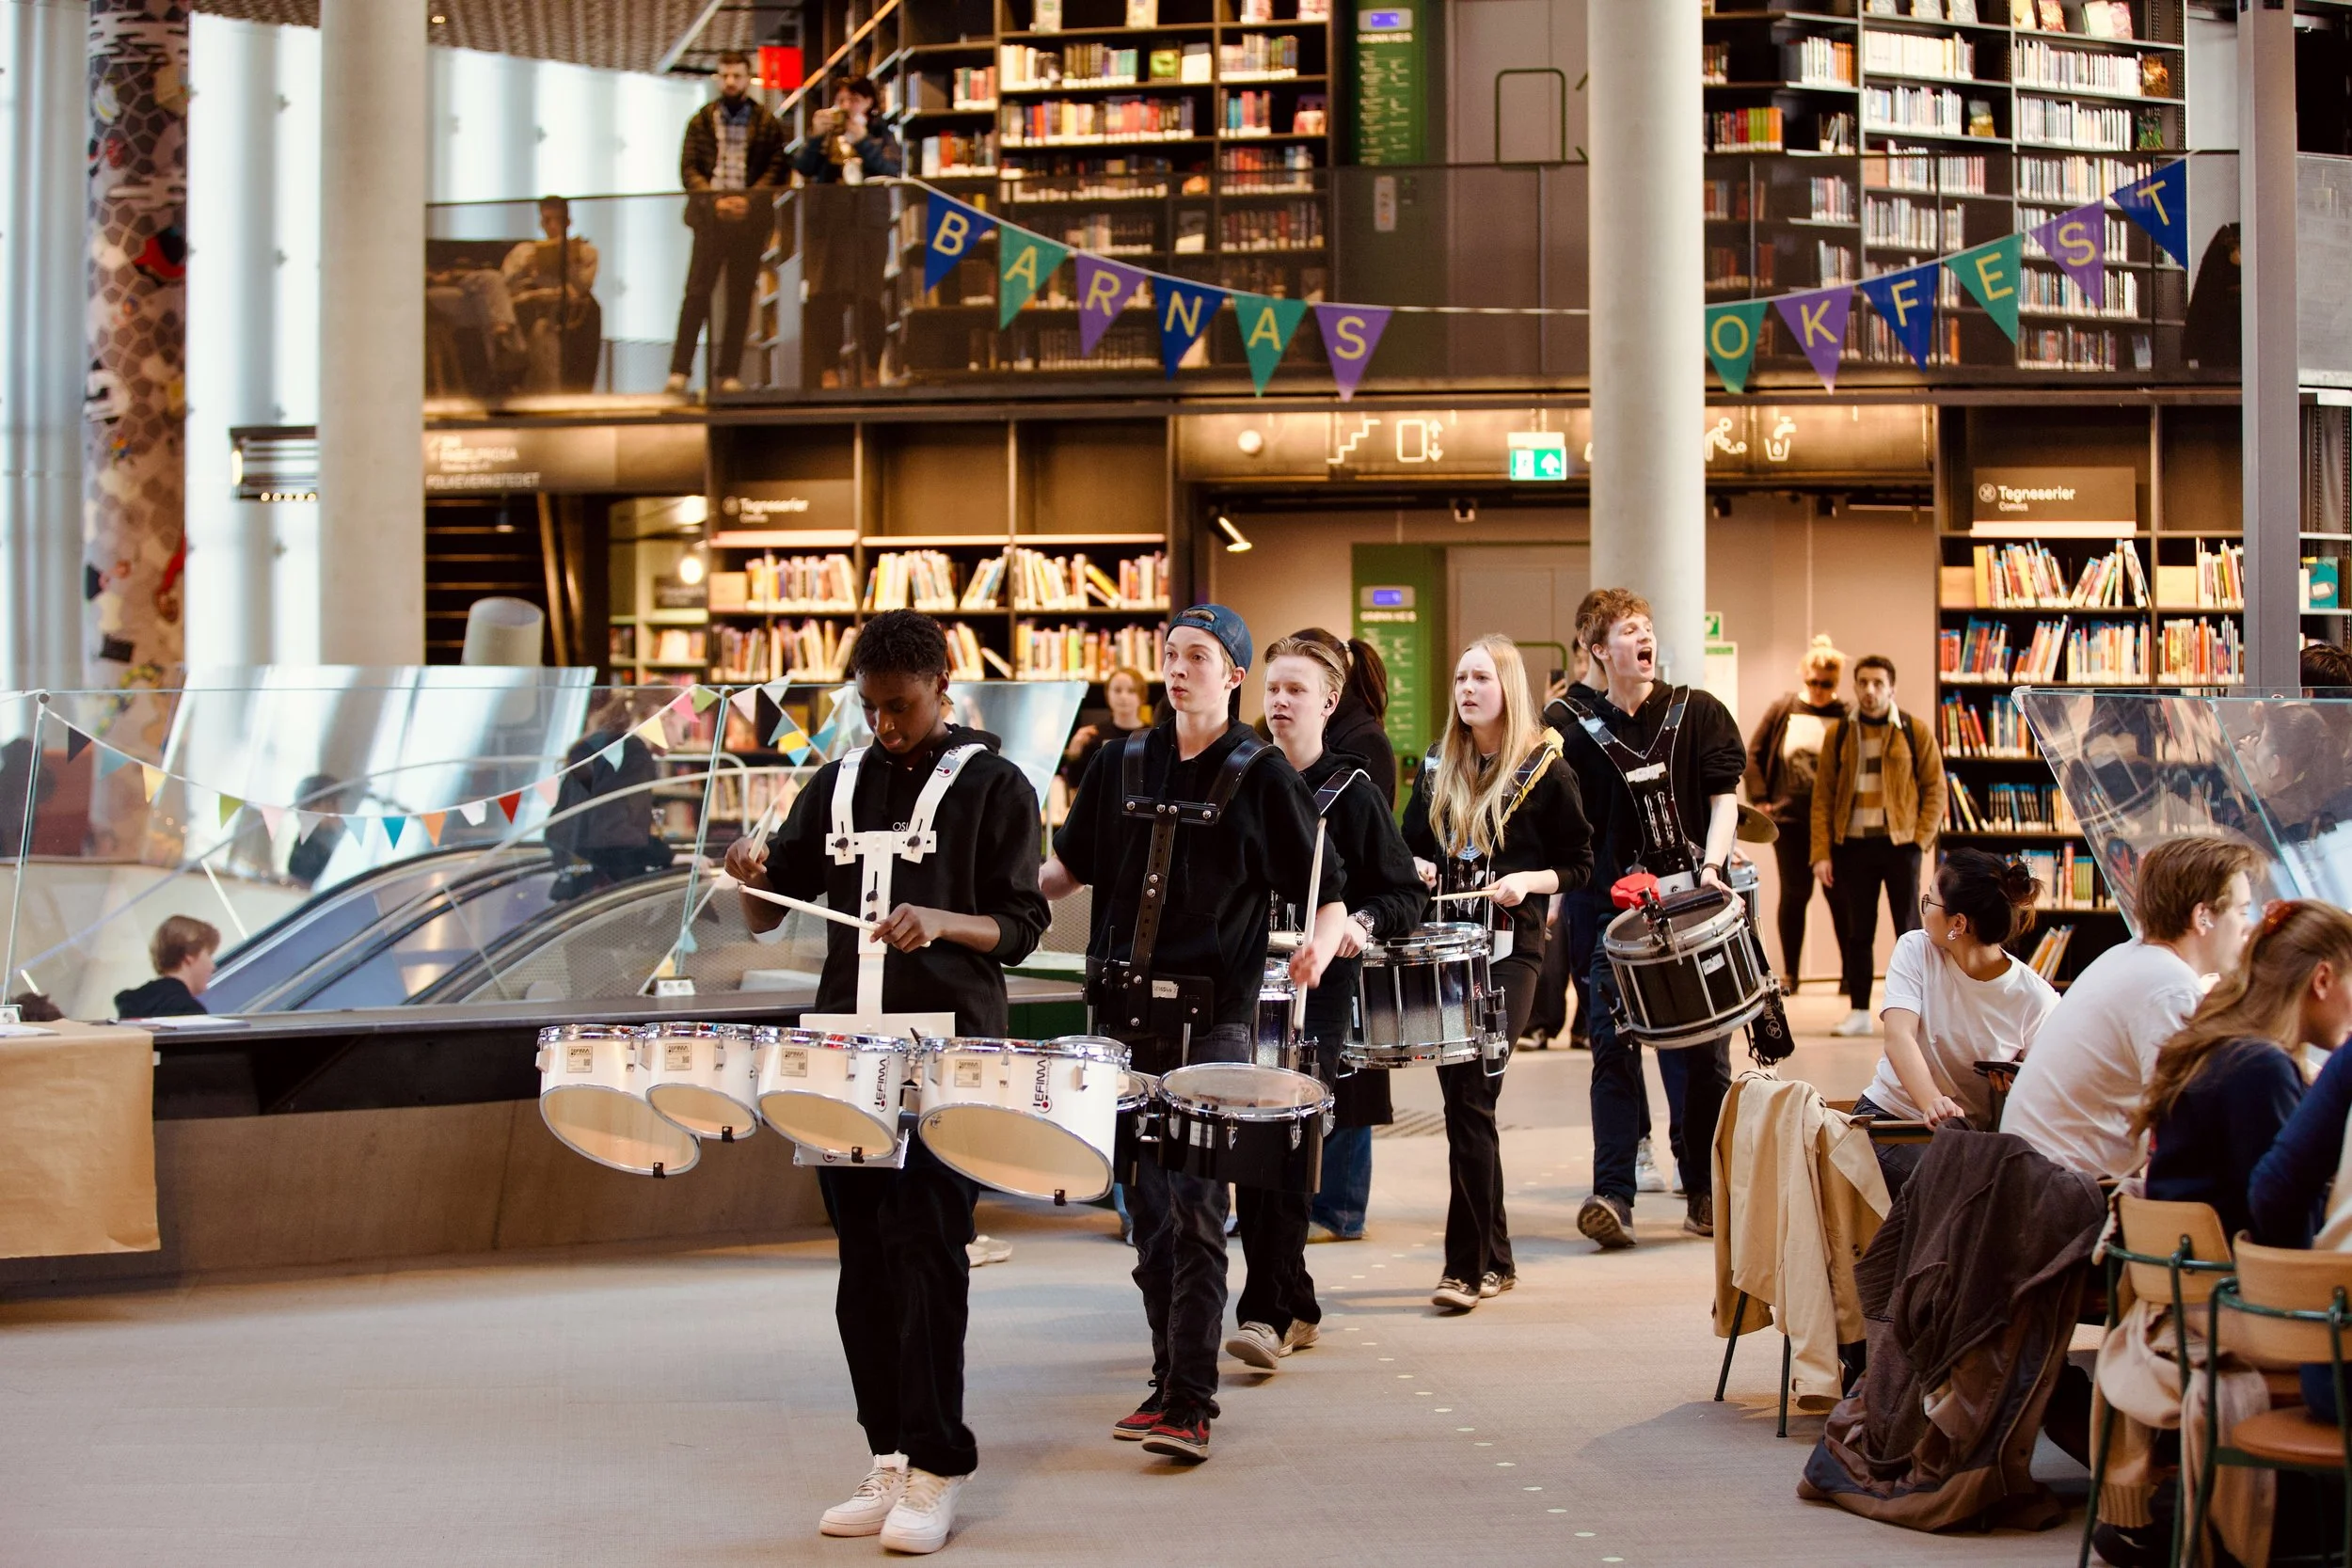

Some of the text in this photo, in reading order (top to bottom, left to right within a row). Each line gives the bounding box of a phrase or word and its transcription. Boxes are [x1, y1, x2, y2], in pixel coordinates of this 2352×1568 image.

[931, 180, 2174, 360] BARNAS OKFEST
[1997, 485, 2075, 503] Tegneserier
[892, 821, 910, 832] OSL
